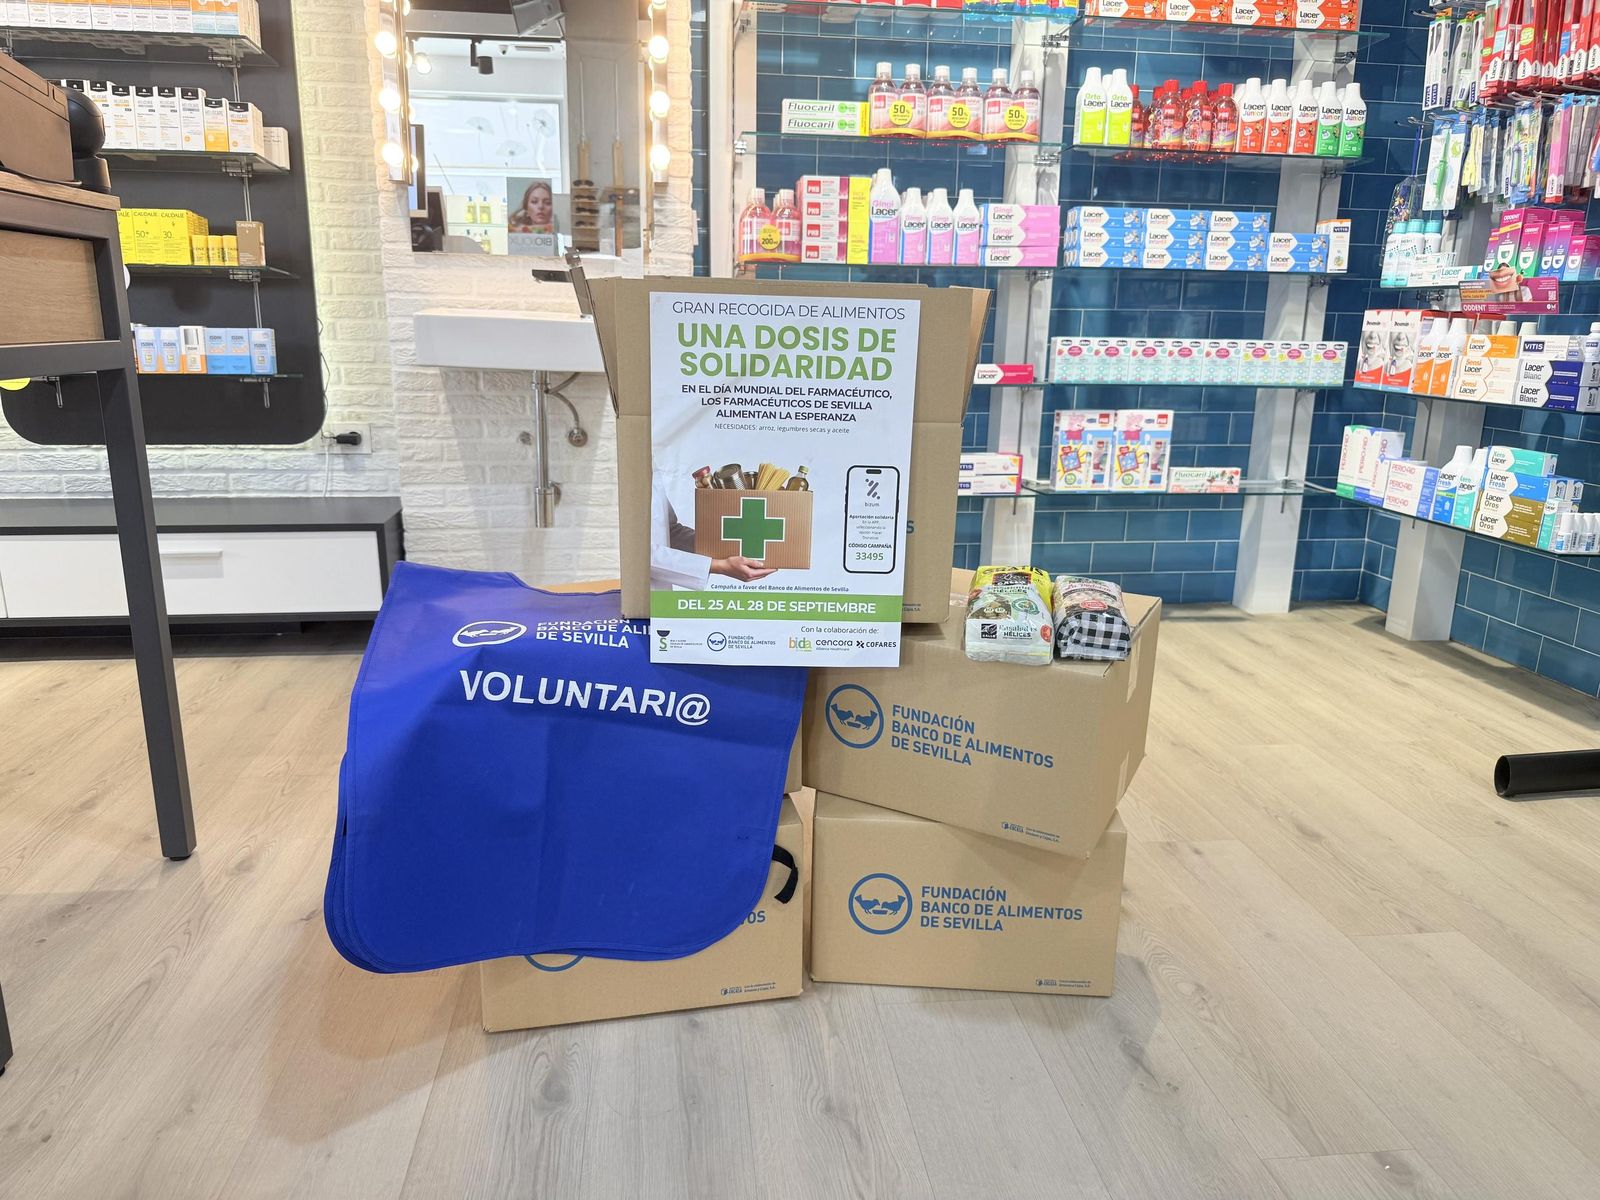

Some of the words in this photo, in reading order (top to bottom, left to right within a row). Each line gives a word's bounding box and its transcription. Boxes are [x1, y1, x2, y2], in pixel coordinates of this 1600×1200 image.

[1169, 3, 1191, 11] Lacer
[1235, 7, 1255, 15] Lacer
[1299, 11, 1320, 19] Lacer
[788, 102, 835, 112] Fluocaril
[1083, 99, 1106, 108] Lacer
[1299, 104, 1318, 112] Lacer
[787, 118, 835, 129] Fluocaril
[871, 207, 898, 216] Lacer
[904, 220, 926, 229] Lacer
[930, 221, 953, 229] Lacer
[957, 221, 979, 229] Lacer
[990, 254, 1011, 262] Lacer
[1083, 250, 1102, 258] Lacer
[672, 301, 714, 315] GRAN
[719, 302, 795, 317] RECOGIDA
[799, 305, 819, 318] DE
[821, 305, 906, 320] ALIMENTOS
[1463, 304, 1486, 312] ODDENT
[677, 322, 746, 349] UNA
[755, 324, 849, 351] DOSIS
[858, 327, 897, 353] DE
[680, 352, 893, 381] SOLIDARIDAD
[1525, 363, 1545, 372] Lacer
[977, 372, 998, 380] Lacer
[1523, 371, 1542, 380] Blanc
[681, 384, 696, 393] EN
[699, 385, 712, 394] EL
[713, 383, 732, 395] DÍA
[734, 386, 783, 395] MUNDIAL
[785, 387, 806, 396] DEL
[807, 386, 893, 400] FARMACÉUTICO,
[1459, 387, 1477, 395] Lacer
[1520, 385, 1541, 395] Lacer
[701, 397, 721, 406] LOS
[723, 396, 812, 409] FARMACÉUTICOS
[814, 401, 828, 409] DE
[830, 401, 872, 410] SEVILLA
[1519, 395, 1538, 403] Blanc
[716, 409, 777, 420] ALIMENTAN
[779, 412, 792, 420] LA
[794, 412, 857, 422] ESPERANZA
[714, 423, 757, 431] NECESIDADES:
[777, 425, 808, 434] legumbres
[1491, 457, 1507, 465] Lacer
[1490, 472, 1509, 483] Lacer
[1489, 480, 1506, 489] Fresh
[1485, 492, 1504, 503] Lacer
[1484, 500, 1500, 509] Oros
[1480, 514, 1499, 524] Lacer
[1479, 521, 1495, 531] Oros
[855, 552, 884, 561] 33495
[711, 583, 736, 591] Campaña
[677, 599, 705, 610] DEL
[708, 600, 724, 611] 25
[726, 600, 745, 611] AL
[747, 601, 764, 611] 28
[766, 601, 786, 612] DE
[789, 602, 876, 614] SEPTIEMBRE
[536, 623, 592, 632] BANCO
[597, 624, 616, 632] DE
[536, 631, 559, 641] DE
[562, 632, 629, 649] SEVILLA
[789, 637, 812, 649] bida
[815, 639, 853, 647] cencora
[459, 669, 712, 726] VOLUNTARI@
[892, 704, 975, 735] FUNDACIÓN
[892, 720, 939, 742] BANCO
[942, 731, 962, 748] DE
[965, 737, 1054, 769] ALIMENTOS
[891, 735, 910, 751] DE
[912, 740, 972, 766] SEVILLA
[921, 885, 1007, 902] FUNDACIÓN
[920, 901, 970, 915] BANCO
[974, 903, 993, 916] DE
[996, 904, 1083, 921] ALIMENTOS
[920, 915, 940, 929] DE
[942, 916, 1004, 932] SEVILLA
